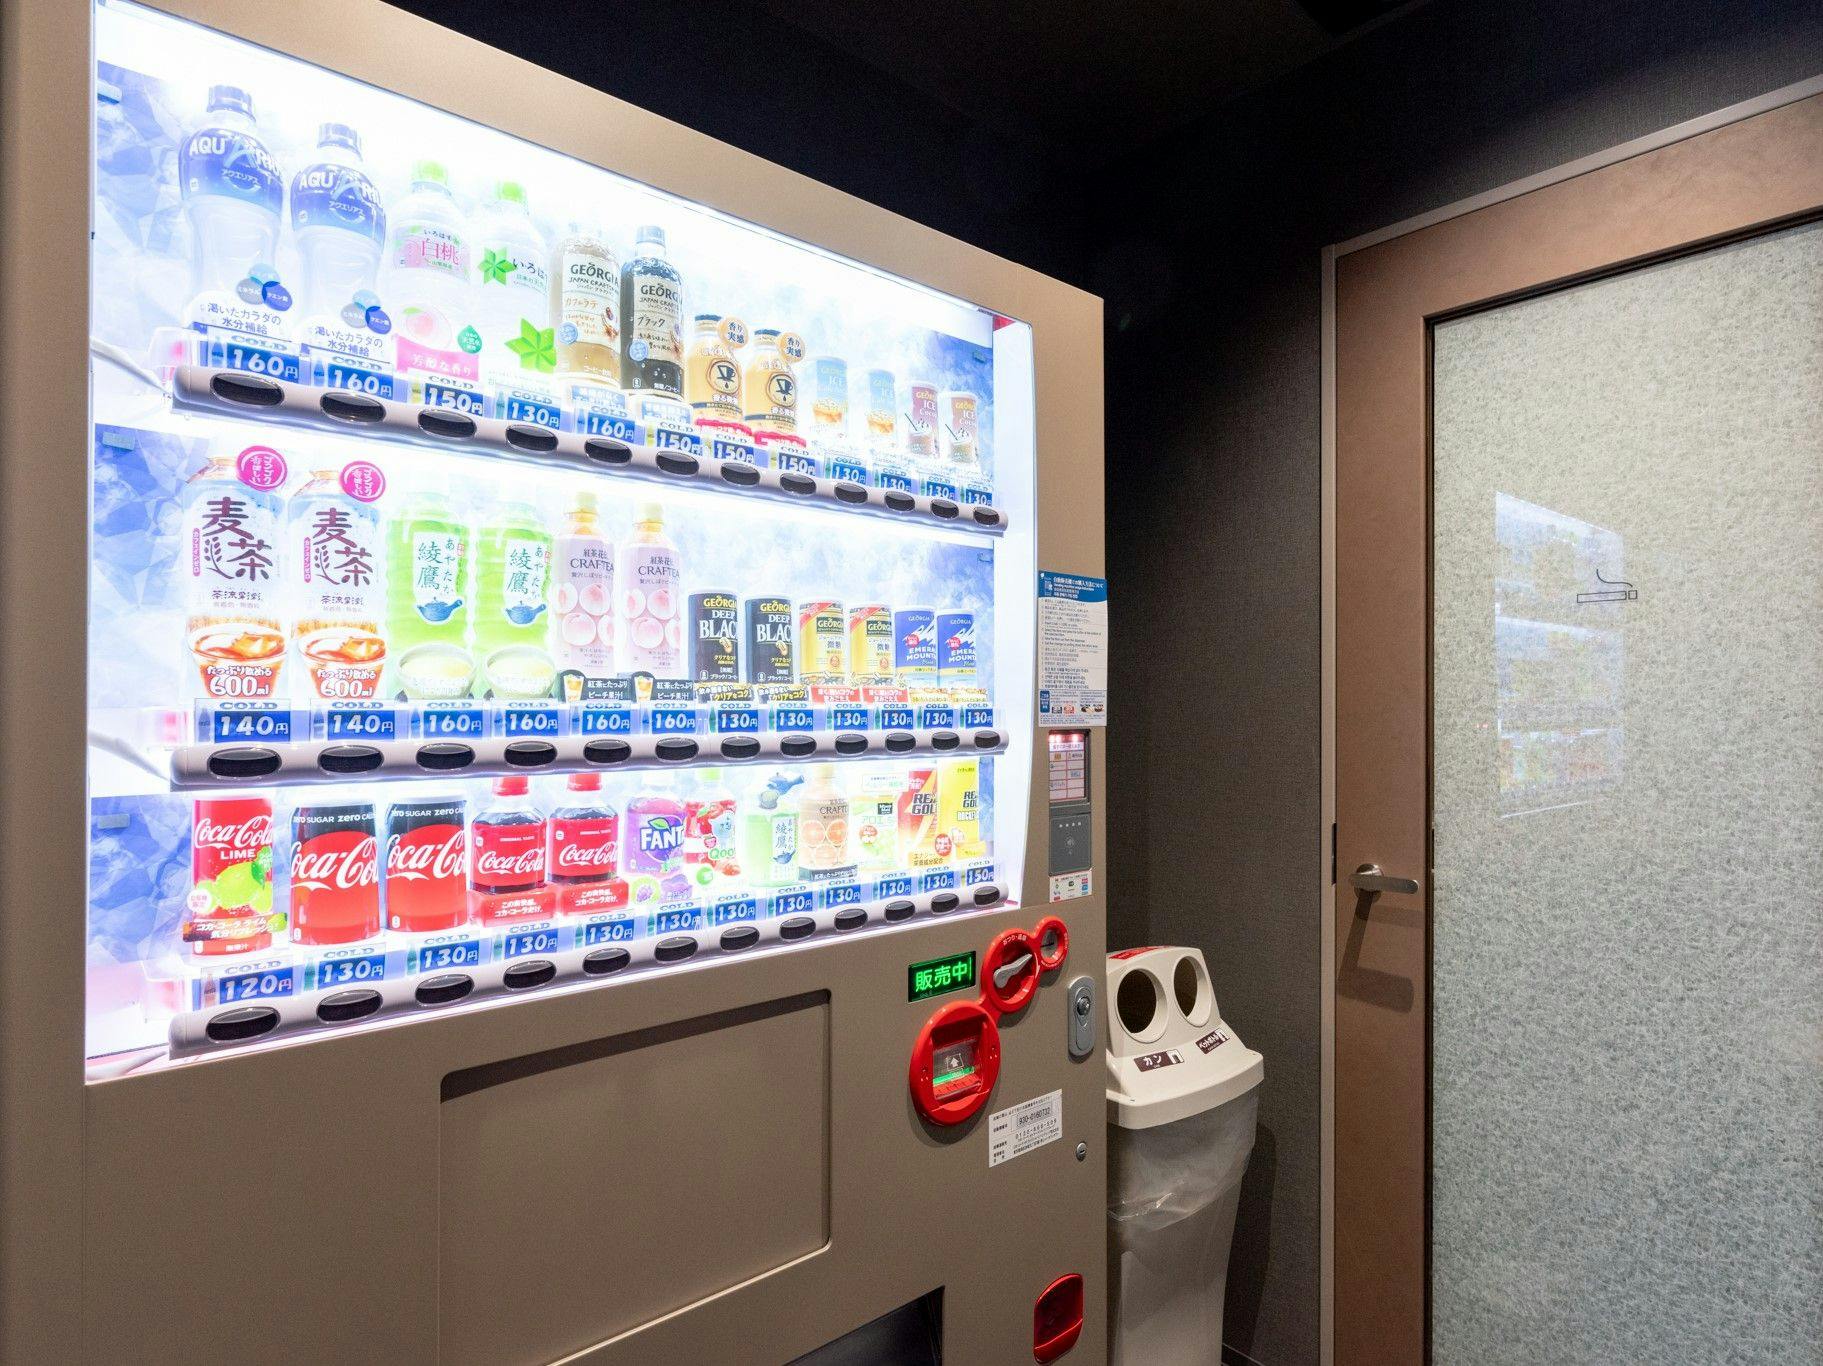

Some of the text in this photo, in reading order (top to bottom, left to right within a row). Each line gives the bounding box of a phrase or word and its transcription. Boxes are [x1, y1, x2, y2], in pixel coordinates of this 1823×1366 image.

[421, 240, 461, 266] 白桃
[222, 317, 268, 335] 水分補給
[231, 335, 287, 351] COLD
[327, 340, 370, 358] 水分補給
[233, 347, 298, 379] 160円
[333, 354, 386, 371] COLD
[336, 367, 392, 396] 160円
[428, 376, 474, 391] COLD
[429, 389, 484, 417] 150円
[512, 391, 552, 405] COLD
[513, 404, 560, 428] 130円
[591, 405, 628, 419] COLD
[592, 417, 635, 441] 160円
[660, 421, 694, 434] COLD
[660, 430, 703, 454] 150円
[718, 442, 755, 464] 150円
[834, 456, 862, 466] COLD
[783, 454, 816, 476] 150円
[202, 497, 273, 581] 麦茶
[313, 507, 374, 587] 麦茶
[417, 541, 443, 591] 綾鷹
[505, 548, 532, 595] 綾鷹
[699, 620, 738, 640] BLAC
[756, 623, 792, 643] BLAC
[907, 654, 936, 662] MOUNT
[209, 676, 271, 698] 600ml
[319, 679, 375, 698] 600ml
[220, 702, 278, 710] COLD
[332, 701, 384, 710] COLD
[585, 702, 622, 710] COLD
[721, 702, 752, 710] COLD
[778, 702, 807, 710] COLD
[967, 701, 989, 709] COLD
[222, 715, 289, 737] 140円
[334, 714, 394, 736] 140円
[428, 714, 482, 733] 160円
[510, 714, 558, 732] 160円
[587, 714, 630, 732] 160円
[656, 713, 695, 732] 160円
[720, 711, 758, 728] 130円
[779, 711, 813, 727] 130円
[835, 711, 867, 726] 130円
[882, 710, 912, 726] 130円
[926, 710, 954, 726] 130円
[966, 709, 993, 725] 130円
[307, 814, 335, 824] SUGAR
[337, 812, 361, 823] zero
[405, 807, 455, 820] SUGAR zero
[911, 803, 938, 815] GOL
[640, 826, 686, 850] FANT
[221, 848, 257, 860] LIME
[881, 871, 908, 881] COLD
[926, 865, 950, 875] COLD
[828, 878, 855, 887] COLD
[881, 878, 912, 896] 130円
[926, 871, 956, 890] 130円
[717, 893, 750, 904] COLD
[778, 885, 807, 897] COLD
[829, 885, 861, 904] 130円
[659, 901, 695, 913] COLD
[719, 901, 755, 922] 130円
[778, 894, 811, 914] 130円
[589, 913, 627, 925] COLD
[509, 922, 551, 935] COLD
[590, 923, 634, 946] 130円
[424, 934, 470, 947] COLD
[509, 933, 557, 958] 130円
[323, 947, 376, 960] COLD
[425, 945, 478, 969] 130円
[225, 960, 282, 977] COLD
[324, 961, 384, 987] 130円
[915, 959, 968, 993] 販売中
[225, 974, 293, 1000] 120円
[1143, 1054, 1163, 1067] カン
